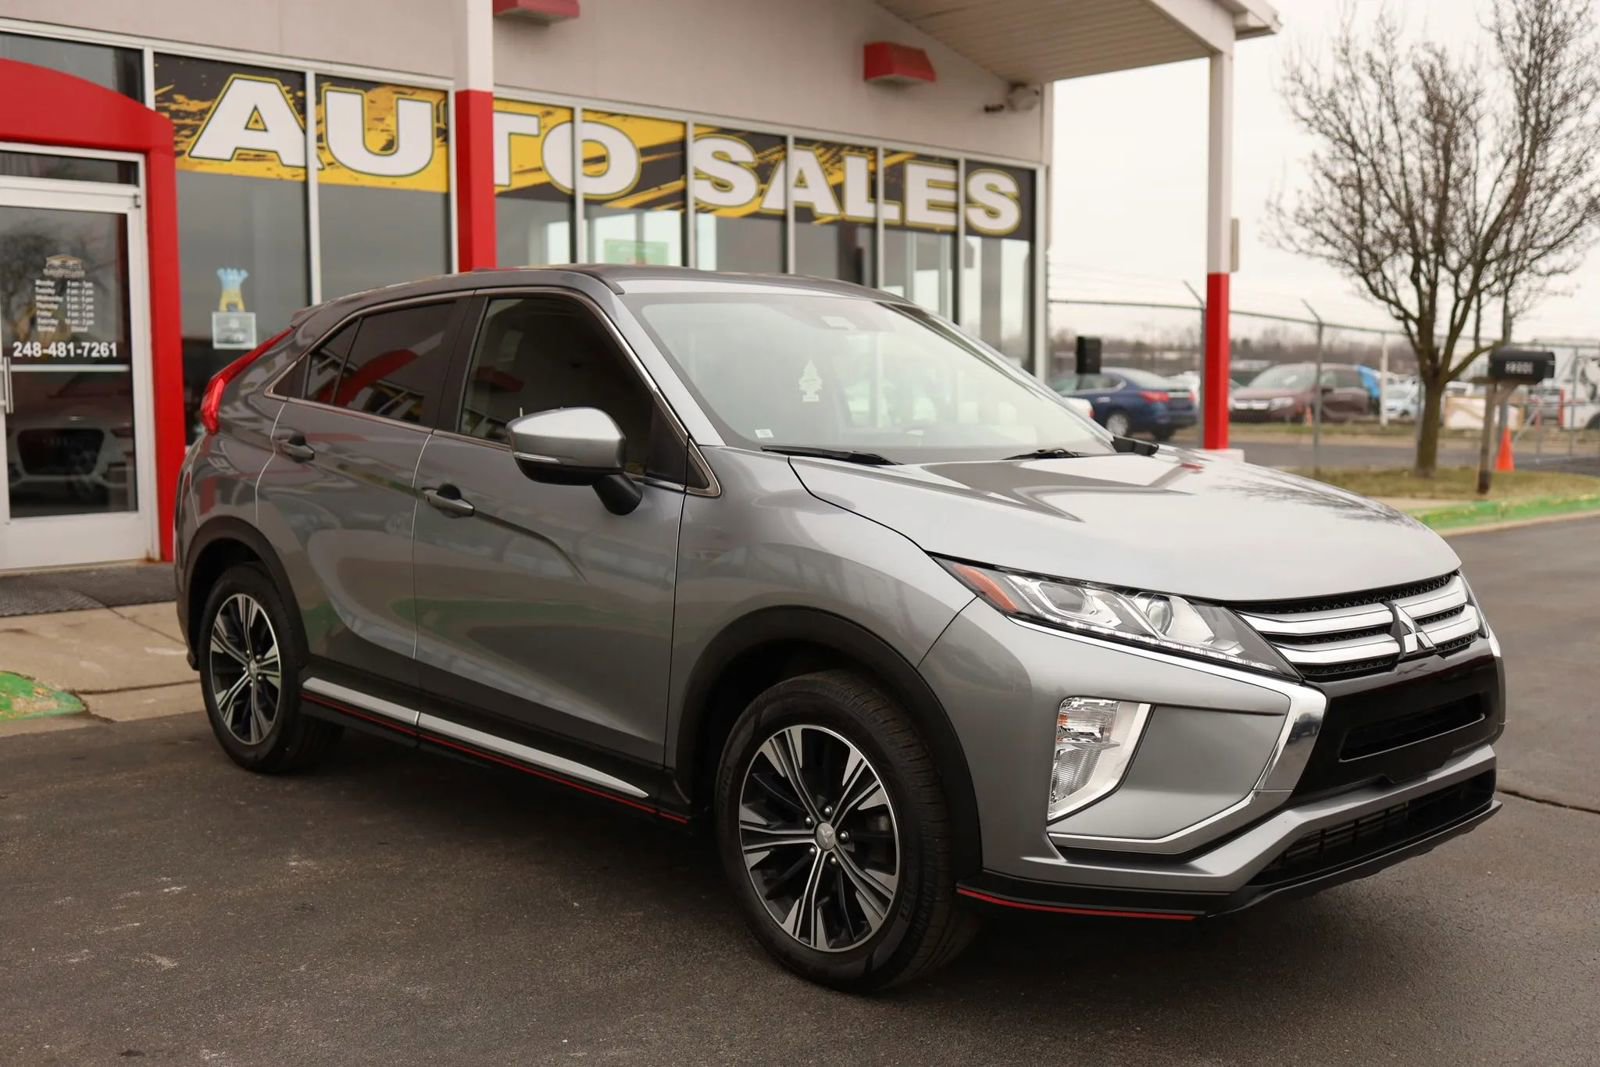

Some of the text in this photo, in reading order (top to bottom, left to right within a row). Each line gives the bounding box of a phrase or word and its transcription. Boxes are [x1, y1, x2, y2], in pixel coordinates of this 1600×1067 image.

[189, 75, 1021, 234] AUTO SALES
[12, 341, 118, 357] 248-481-7261
